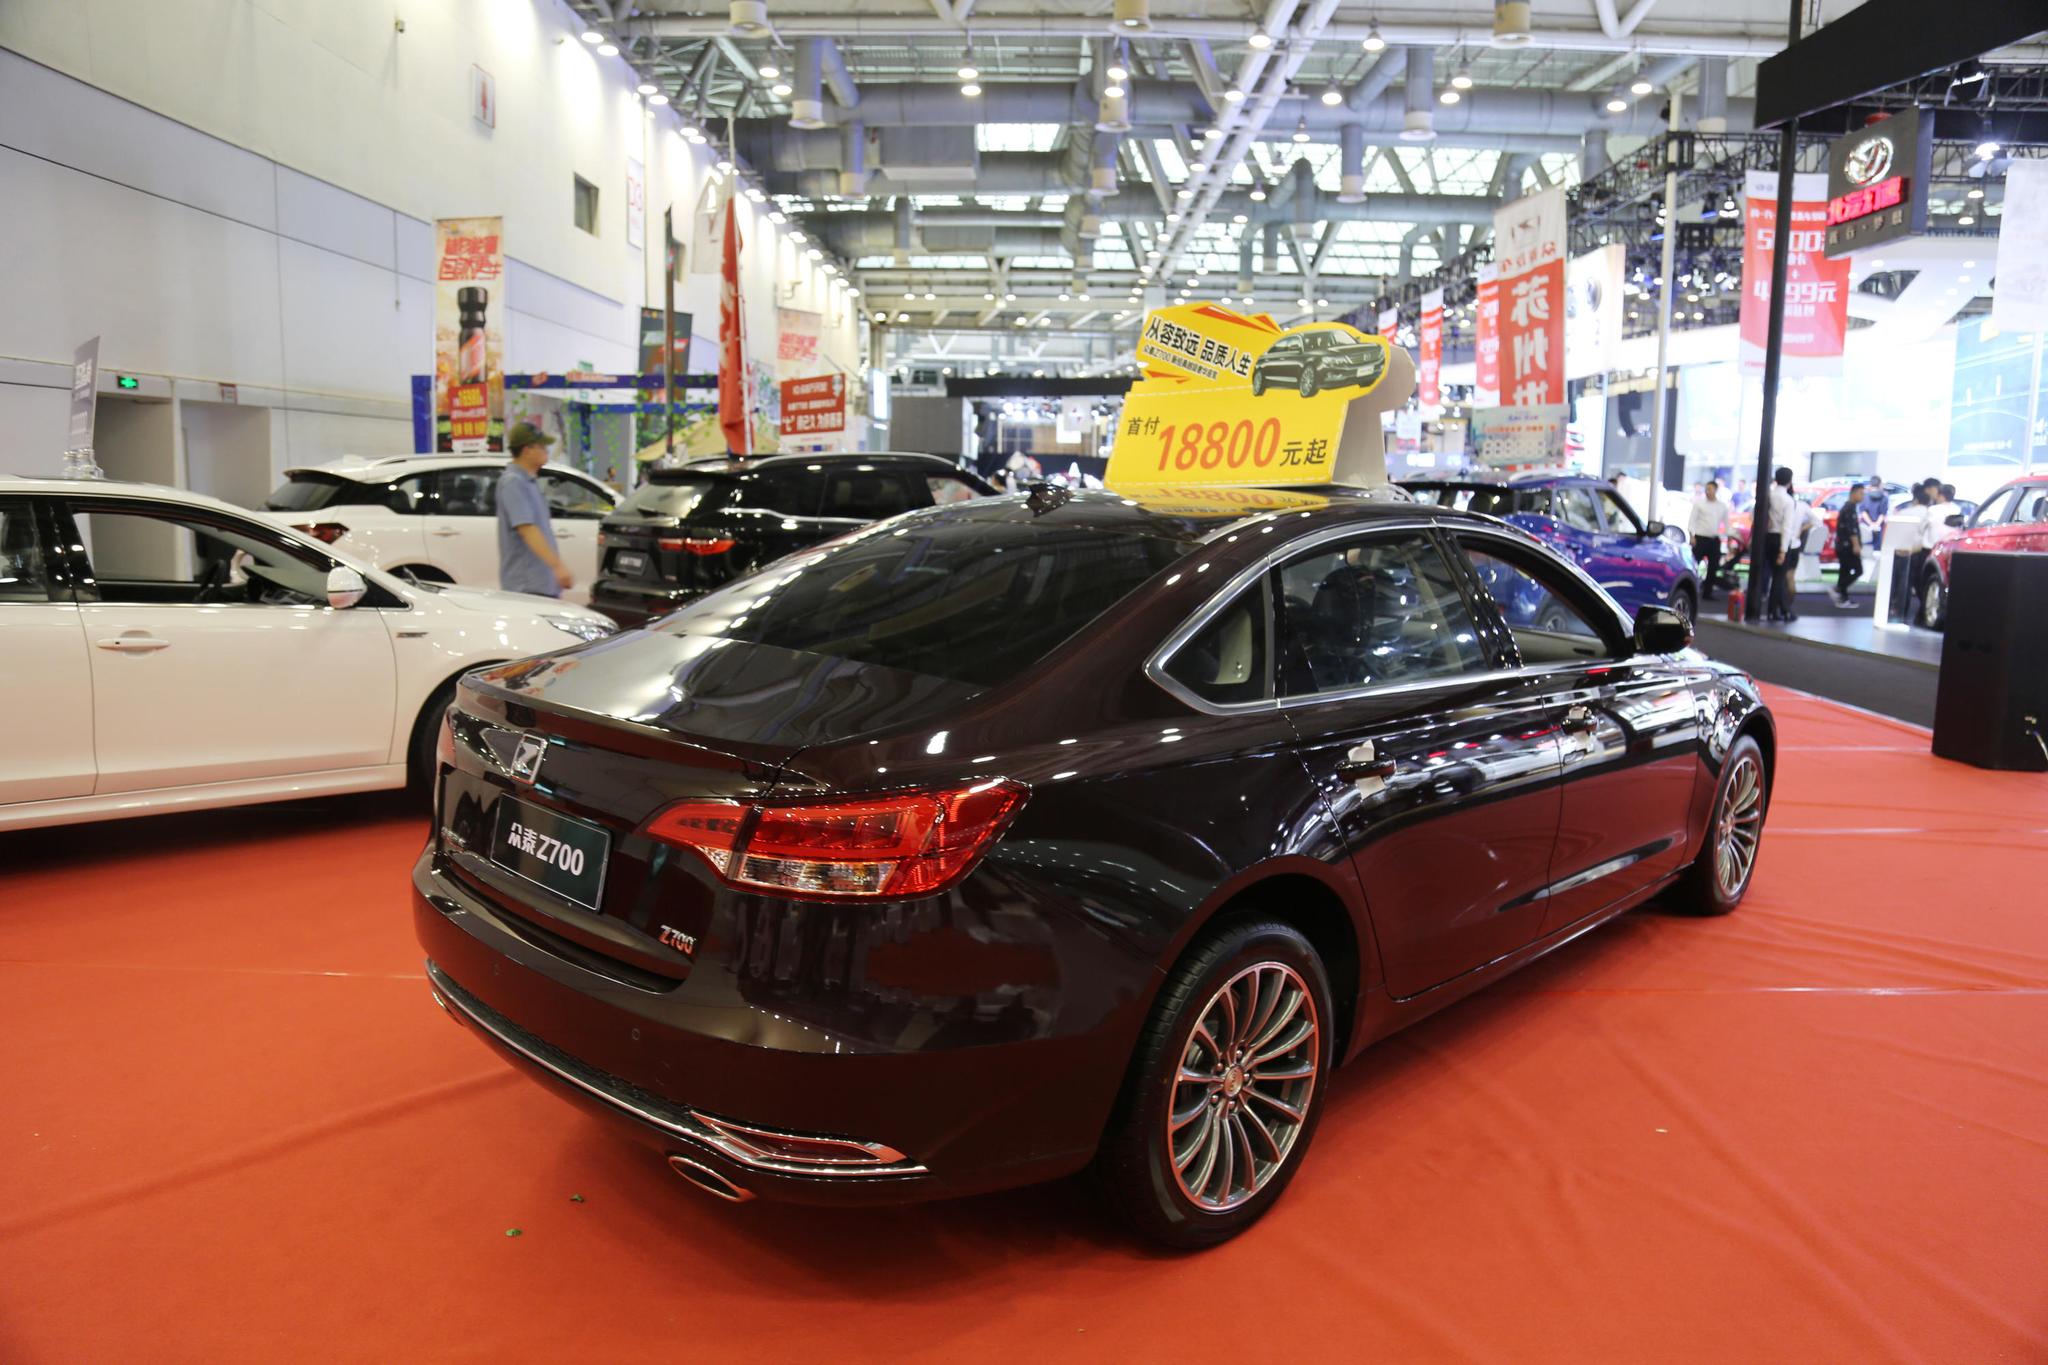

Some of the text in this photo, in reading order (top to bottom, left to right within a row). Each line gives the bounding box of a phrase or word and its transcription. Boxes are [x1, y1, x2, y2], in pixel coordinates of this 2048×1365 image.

[1753, 279, 1837, 305] 499元
[1145, 316, 1251, 376] 从容致远 品质人生
[507, 822, 585, 876] 众泰Z700
[659, 924, 696, 954] Z700
